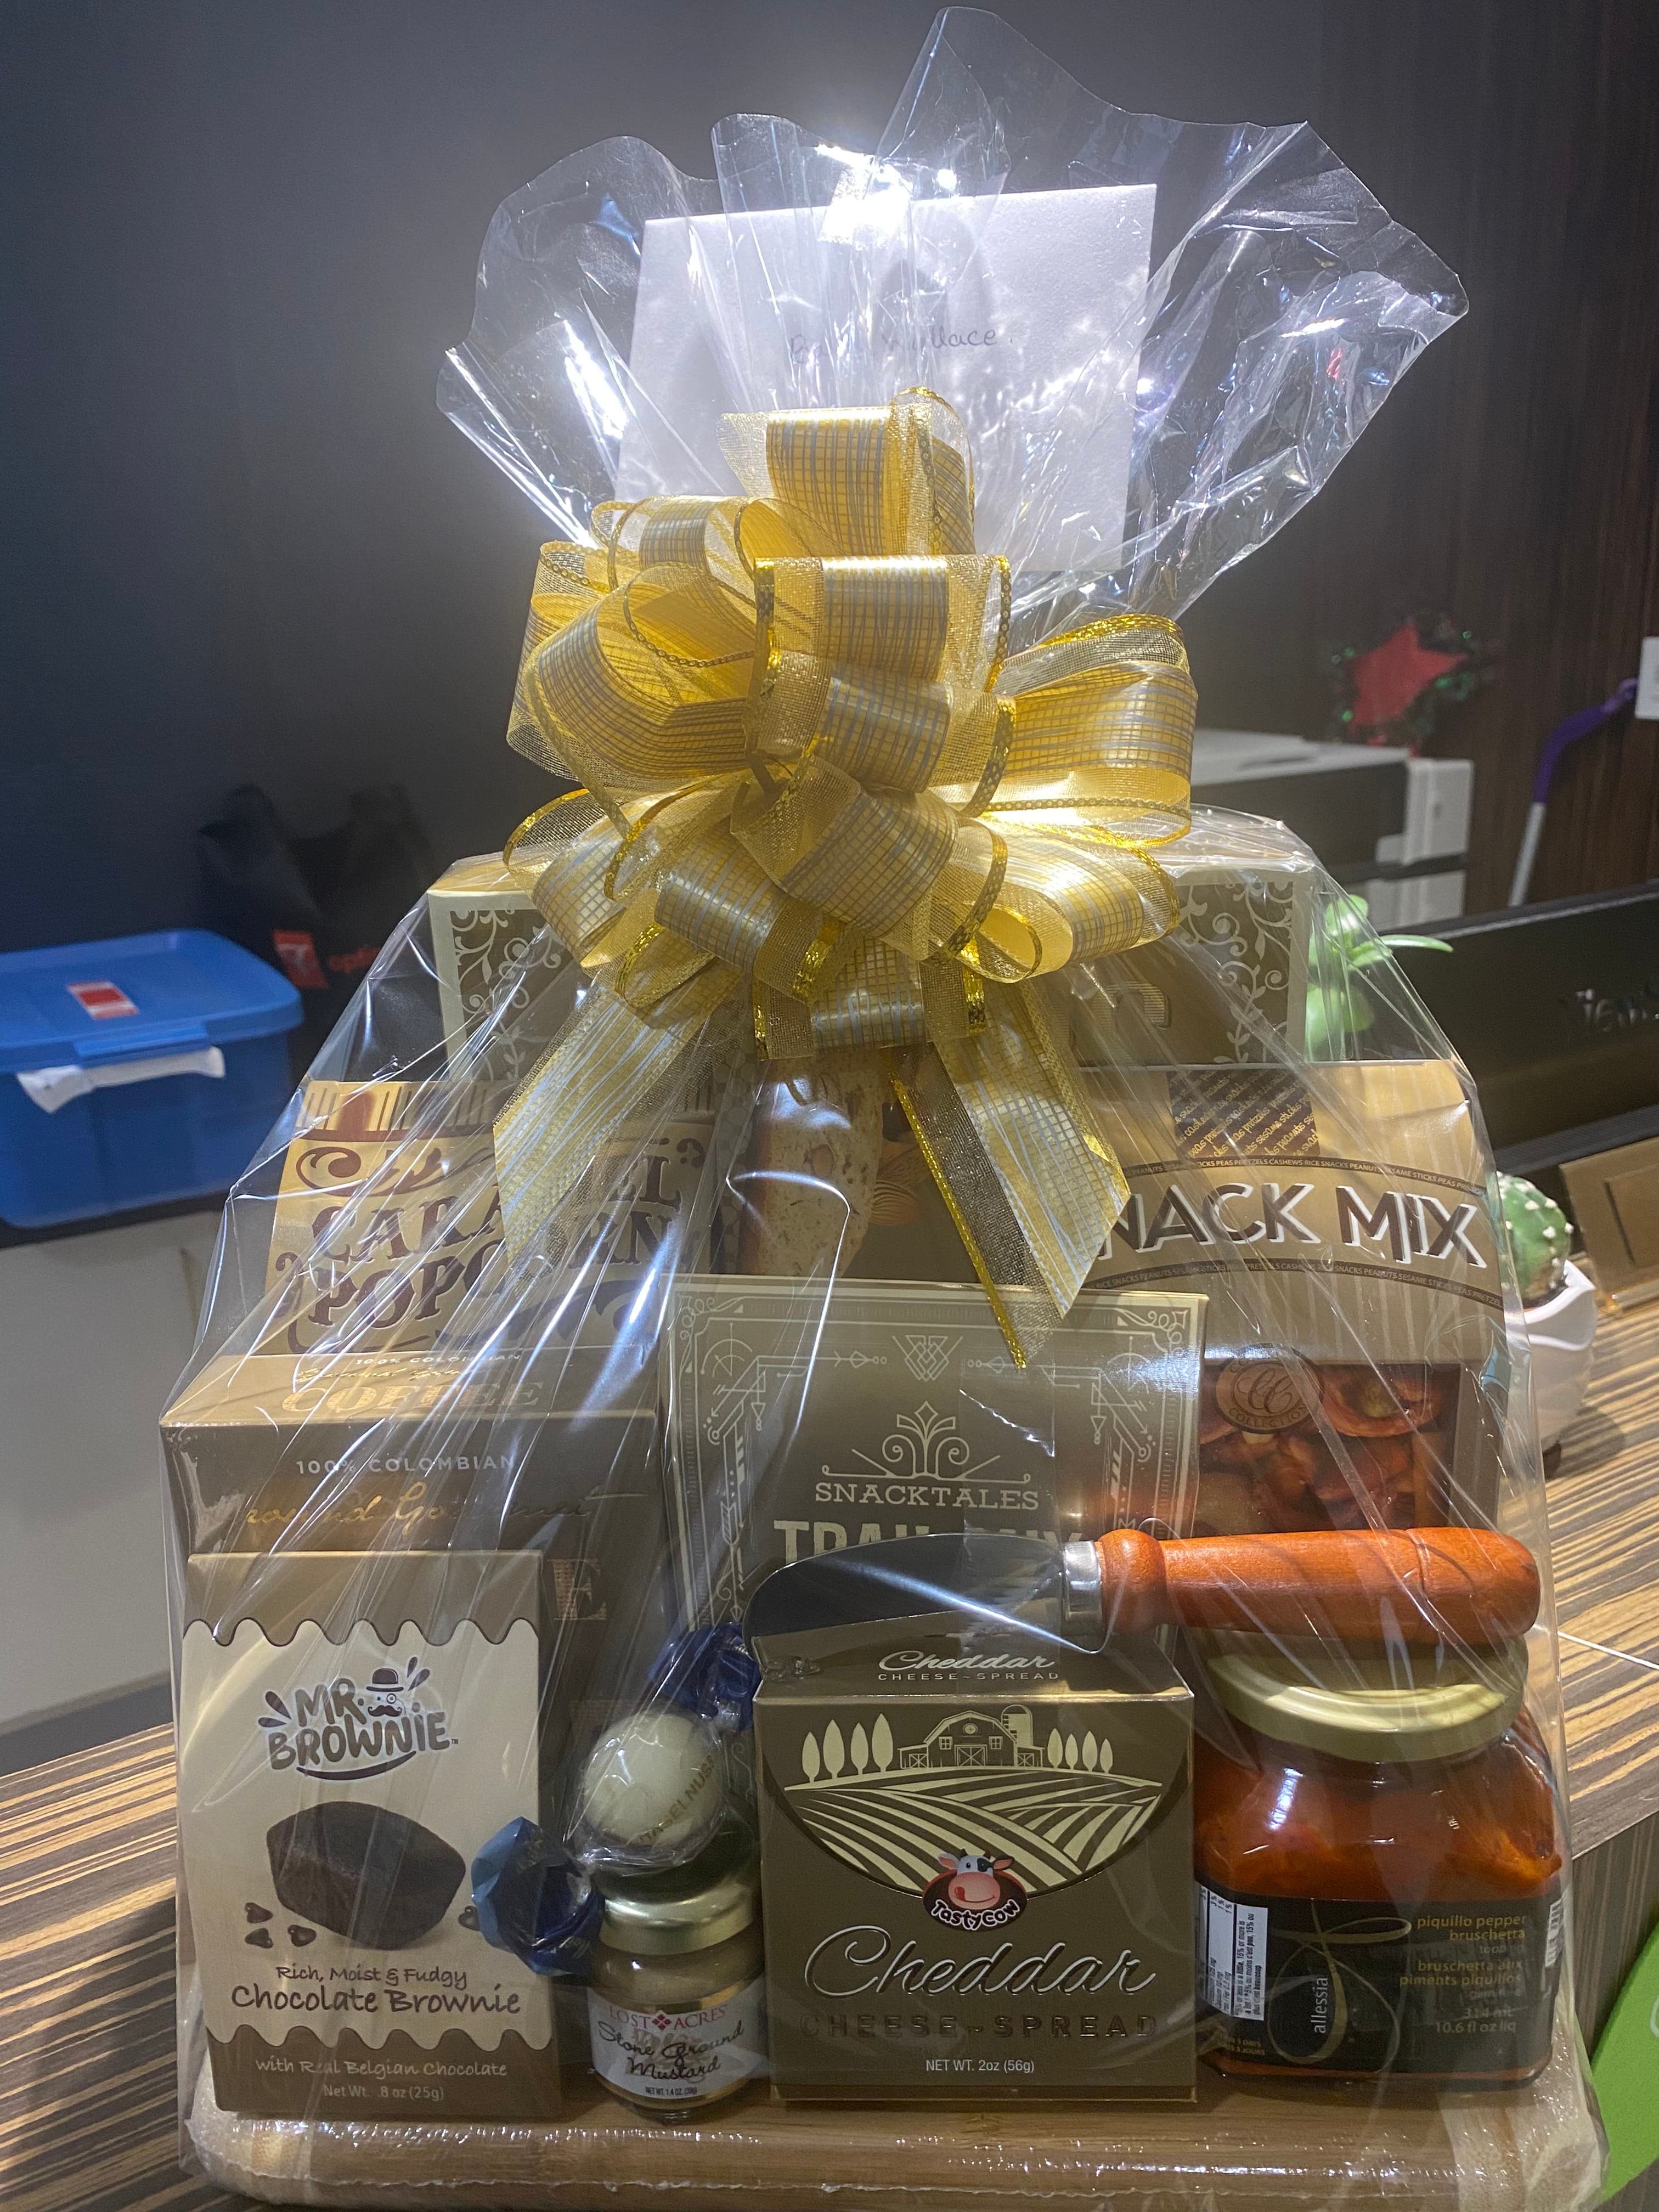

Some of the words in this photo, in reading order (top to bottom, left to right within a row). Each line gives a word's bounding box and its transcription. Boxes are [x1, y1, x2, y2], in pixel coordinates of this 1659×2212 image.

[1321, 1160, 1349, 1169] SNACKS
[1413, 1171, 1437, 1182] STICKS
[1097, 1183, 1322, 1261] NACK
[1335, 1185, 1488, 1269] MIX
[1335, 1265, 1363, 1276] SNACKS
[1363, 1268, 1398, 1280] PEANUTS
[1398, 1273, 1427, 1285] SESAME
[370, 1454, 514, 1474] COLOMBIAN
[815, 1482, 1039, 1510] SNACKTALES
[878, 1650, 1056, 1671] Cheddar
[268, 1702, 450, 1771] BROWNIE
[1417, 1915, 1472, 1930] piquillo
[1476, 1915, 1527, 1929] pepper
[1449, 1928, 1526, 1940] bruschetta
[804, 1925, 1157, 2000] Cheddar
[276, 1963, 324, 1984] Rich,
[330, 1966, 382, 1982] Moist
[403, 1967, 467, 1990] Fudgy
[230, 1983, 379, 2013] Chocolate
[384, 1983, 521, 2015] Brownie
[1310, 1977, 1329, 2034] allessia
[610, 2005, 652, 2029] LOST
[673, 2004, 730, 2030] ACRES
[597, 2020, 656, 2056] Stone
[661, 2019, 746, 2059] Ground
[255, 2055, 294, 2073] with
[343, 2059, 419, 2081] Belgian
[422, 2061, 508, 2076] Chocolate
[627, 2056, 721, 2084] Mustard
[926, 2059, 950, 2072] NET
[953, 2059, 975, 2072] WT.
[979, 2059, 1000, 2072] 2oz
[1003, 2058, 1035, 2074] (56g)
[324, 2085, 346, 2097] Net
[392, 2088, 406, 2098] oz
[409, 2086, 445, 2102] (25g)
